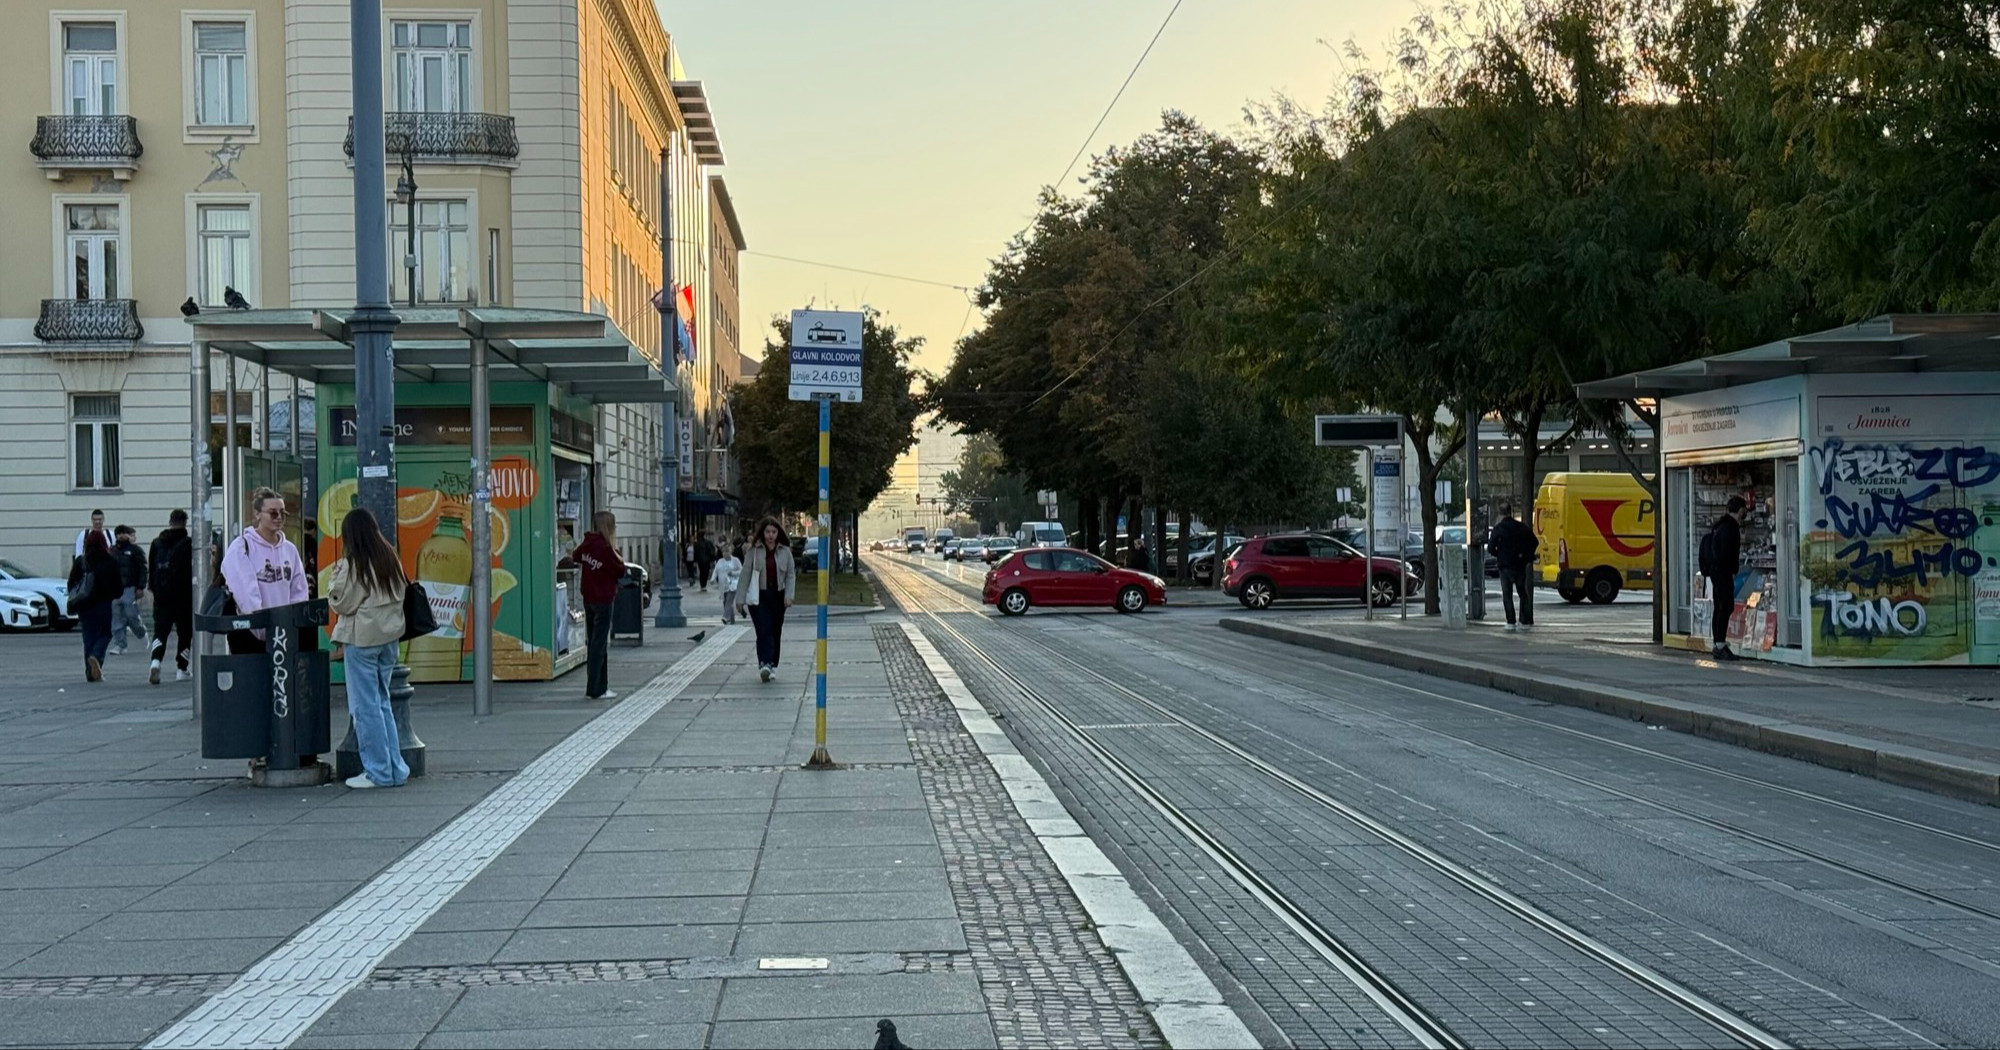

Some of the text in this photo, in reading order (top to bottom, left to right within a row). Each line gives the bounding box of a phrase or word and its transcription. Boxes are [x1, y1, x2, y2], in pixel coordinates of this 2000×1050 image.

[792, 351, 861, 363] GLAVNI KOLODVOR
[1870, 406, 1891, 414] 1828
[1848, 415, 1912, 430] Jamnica
[681, 421, 691, 475] HOTEL
[489, 467, 535, 498] NOVO
[1858, 487, 1901, 495] ZAGREBA
